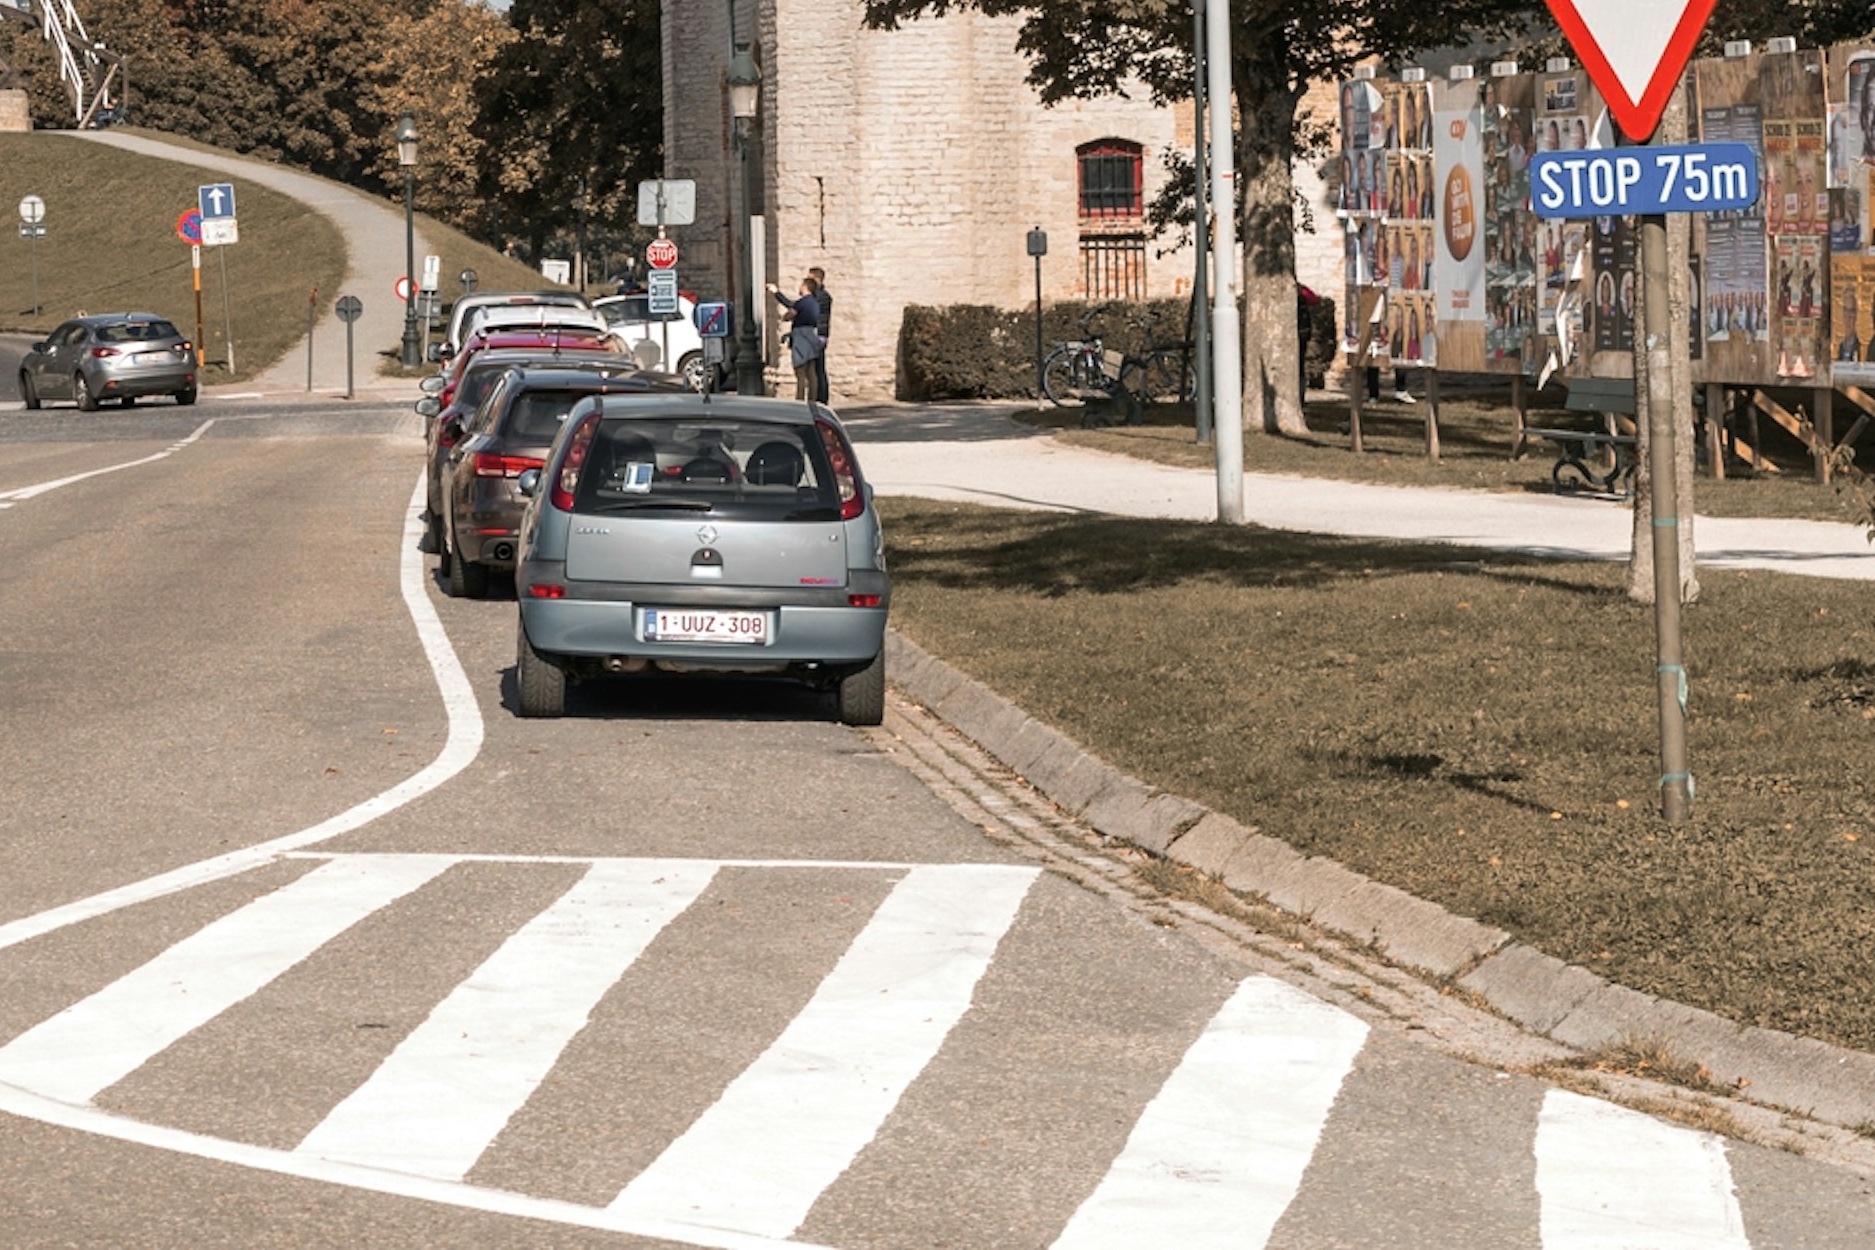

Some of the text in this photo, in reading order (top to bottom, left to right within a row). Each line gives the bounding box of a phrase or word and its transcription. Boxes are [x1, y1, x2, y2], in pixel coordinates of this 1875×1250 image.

[1540, 153, 1748, 209] STOP 75m
[648, 249, 676, 261] STOP
[661, 615, 762, 634] 1-UUZ-308
